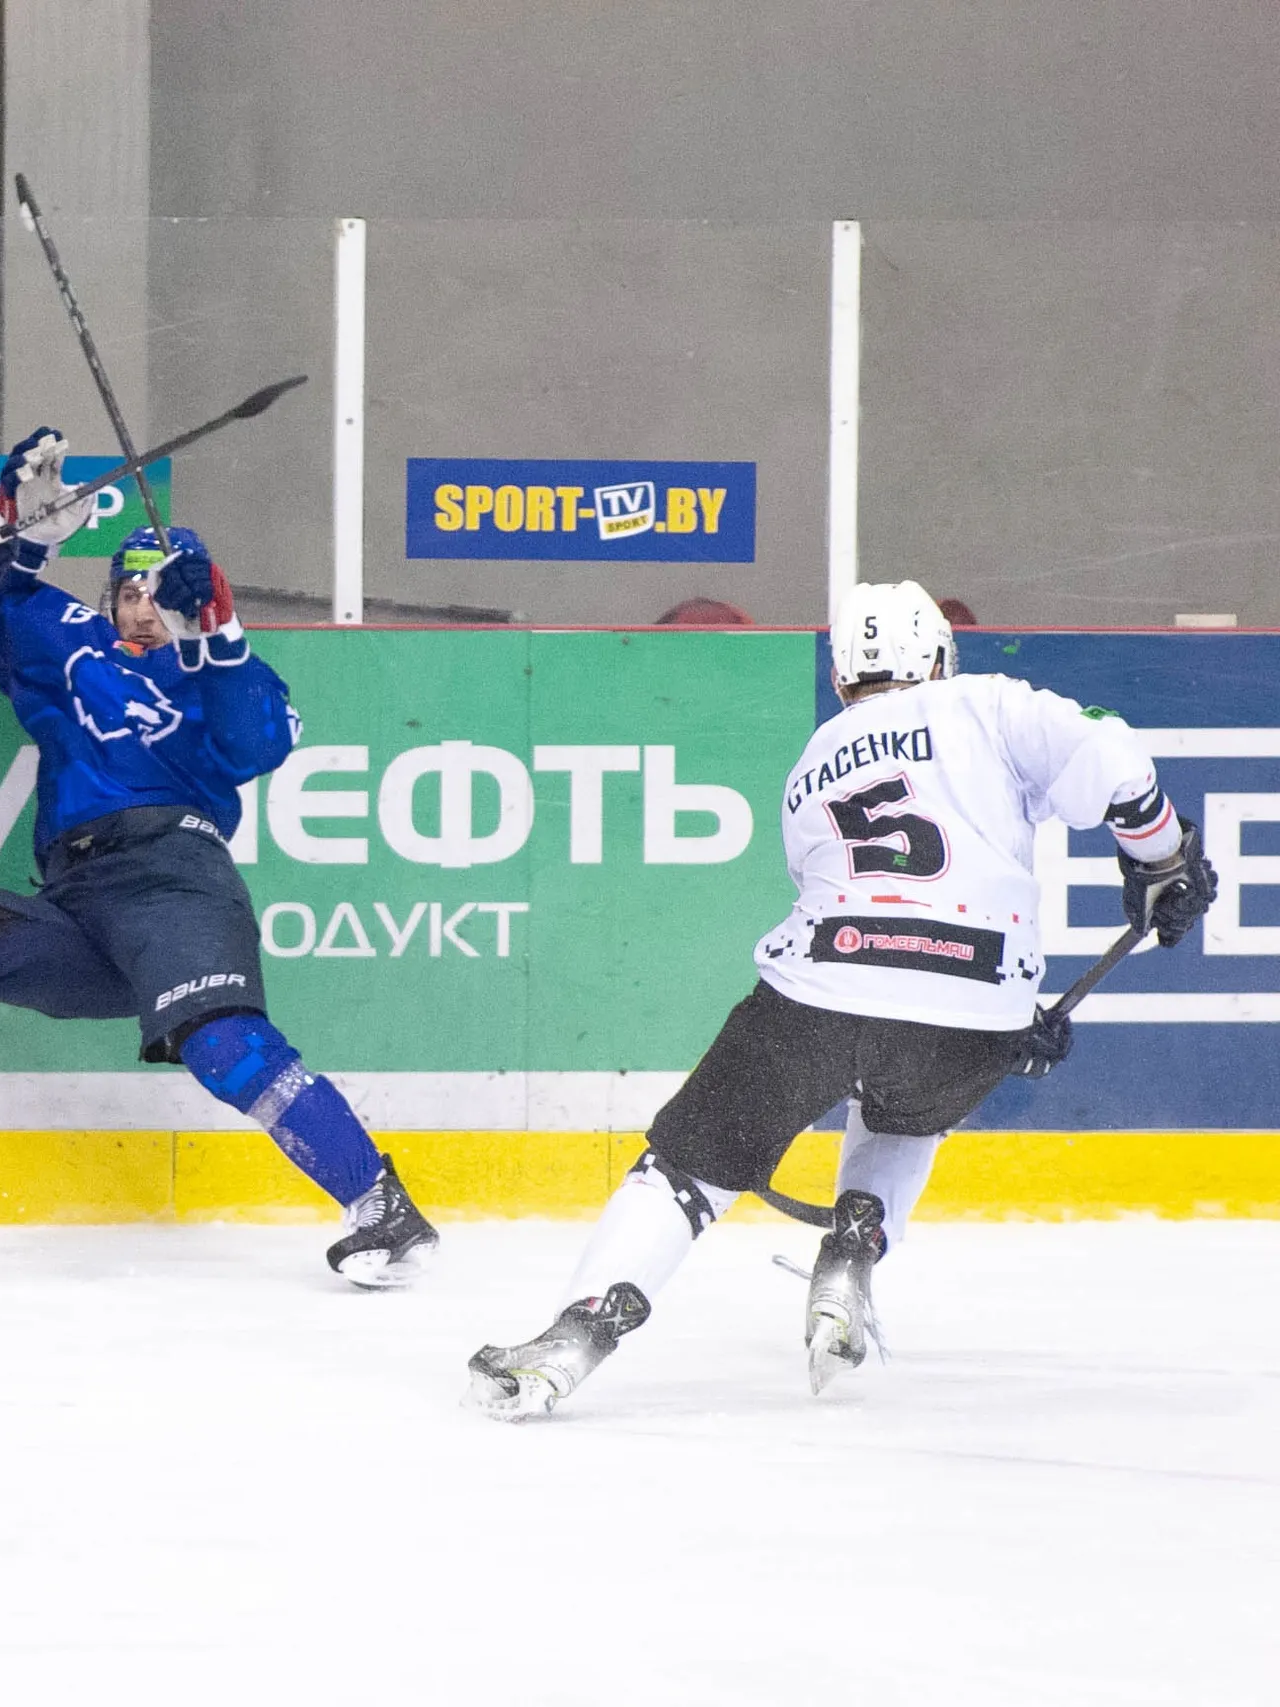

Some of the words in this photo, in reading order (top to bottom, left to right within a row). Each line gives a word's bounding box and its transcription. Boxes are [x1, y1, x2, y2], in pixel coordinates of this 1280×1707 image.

[602, 486, 646, 516] TV
[606, 515, 649, 534] SPORT
[863, 615, 879, 640] 5
[787, 724, 933, 815] СТАСЕНКО
[822, 771, 951, 882] 5
[261, 902, 531, 958] ОДУКТ
[154, 973, 247, 1012] BAUER
